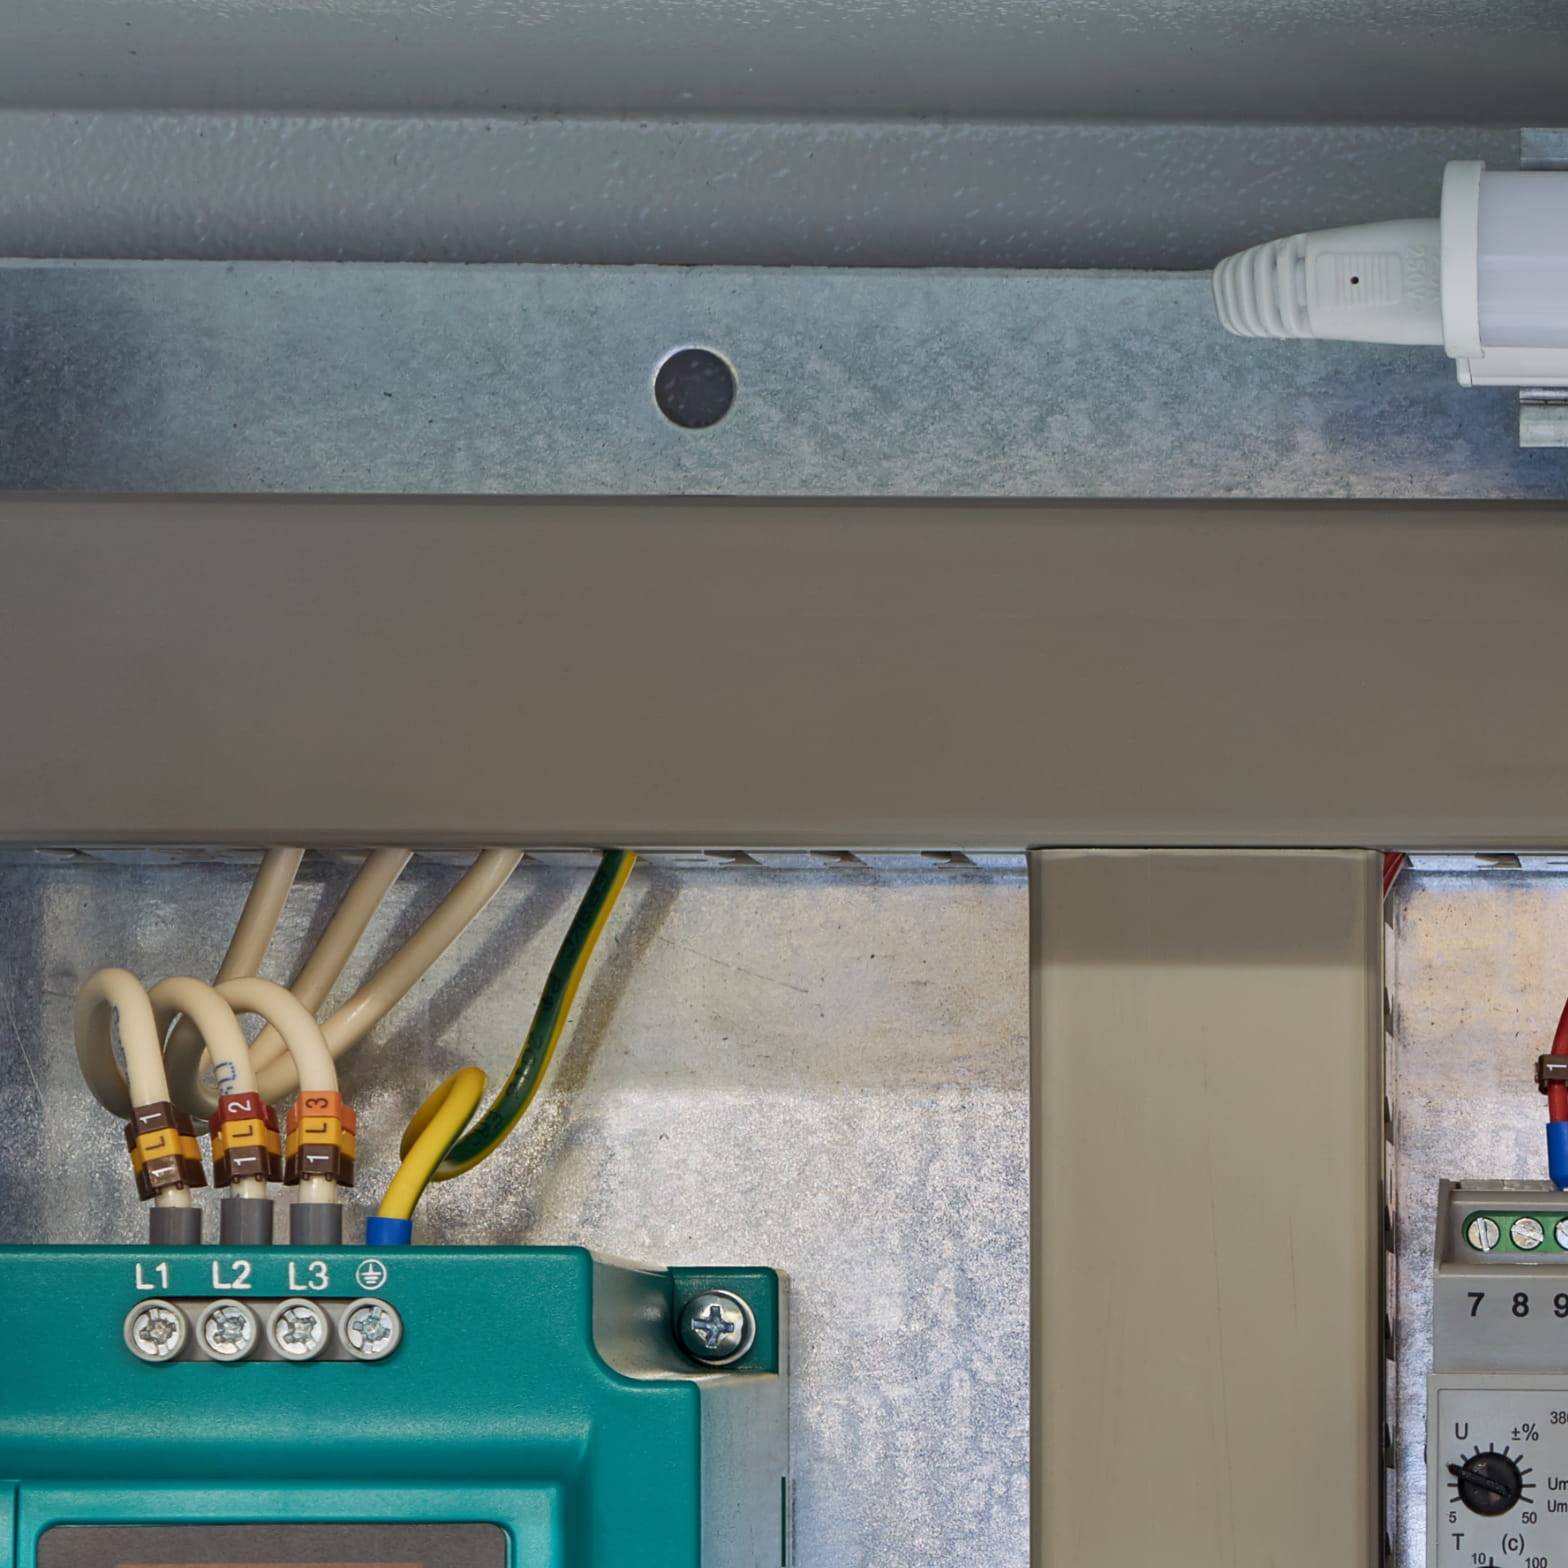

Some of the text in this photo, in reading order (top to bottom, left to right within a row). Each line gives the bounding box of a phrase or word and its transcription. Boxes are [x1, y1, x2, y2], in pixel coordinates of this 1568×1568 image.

[136, 1263, 170, 1289] L1
[212, 1261, 252, 1289] L2
[288, 1261, 329, 1291] L3
[1468, 1292, 1485, 1317] 7
[1512, 1293, 1529, 1318] 8
[1455, 1422, 1539, 1441] U ±%
[1522, 1512, 1537, 1525] 50
[1452, 1533, 1526, 1552] T (c)
[1471, 1553, 1486, 1565] 10
